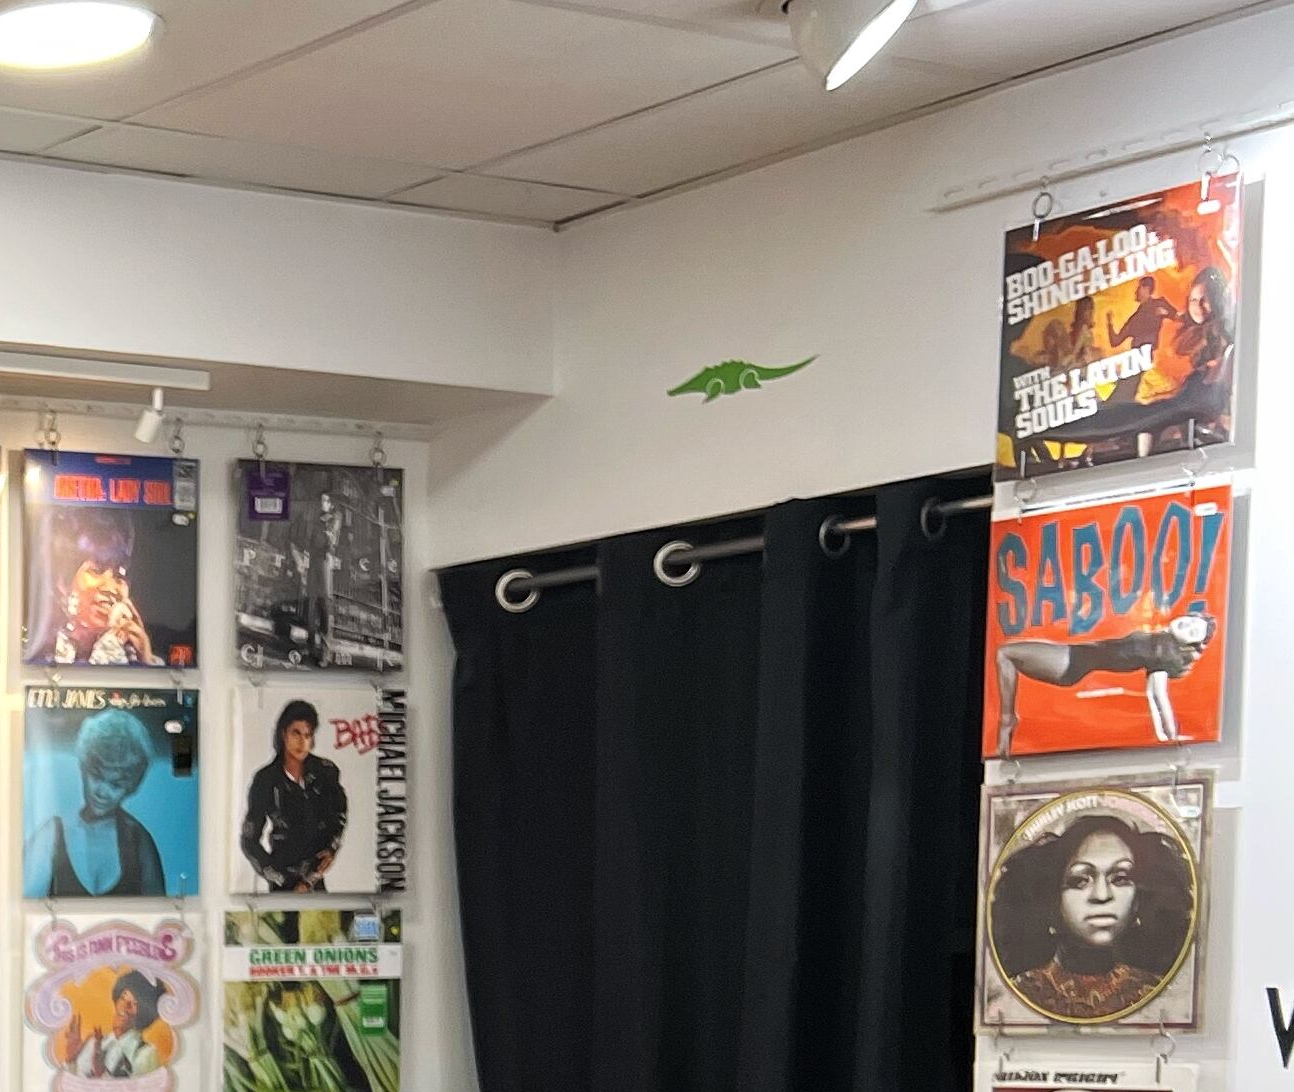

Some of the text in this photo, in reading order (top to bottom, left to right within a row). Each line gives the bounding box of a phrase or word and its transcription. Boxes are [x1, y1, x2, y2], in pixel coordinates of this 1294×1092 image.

[1013, 366, 1050, 388] WITH
[1014, 344, 1154, 413] THE LATIN
[1015, 390, 1099, 439] SOULS
[997, 501, 1226, 637] SABOO!
[376, 688, 406, 893] MICHAEL JACKSON
[249, 947, 379, 965] GREEN ONIONS
